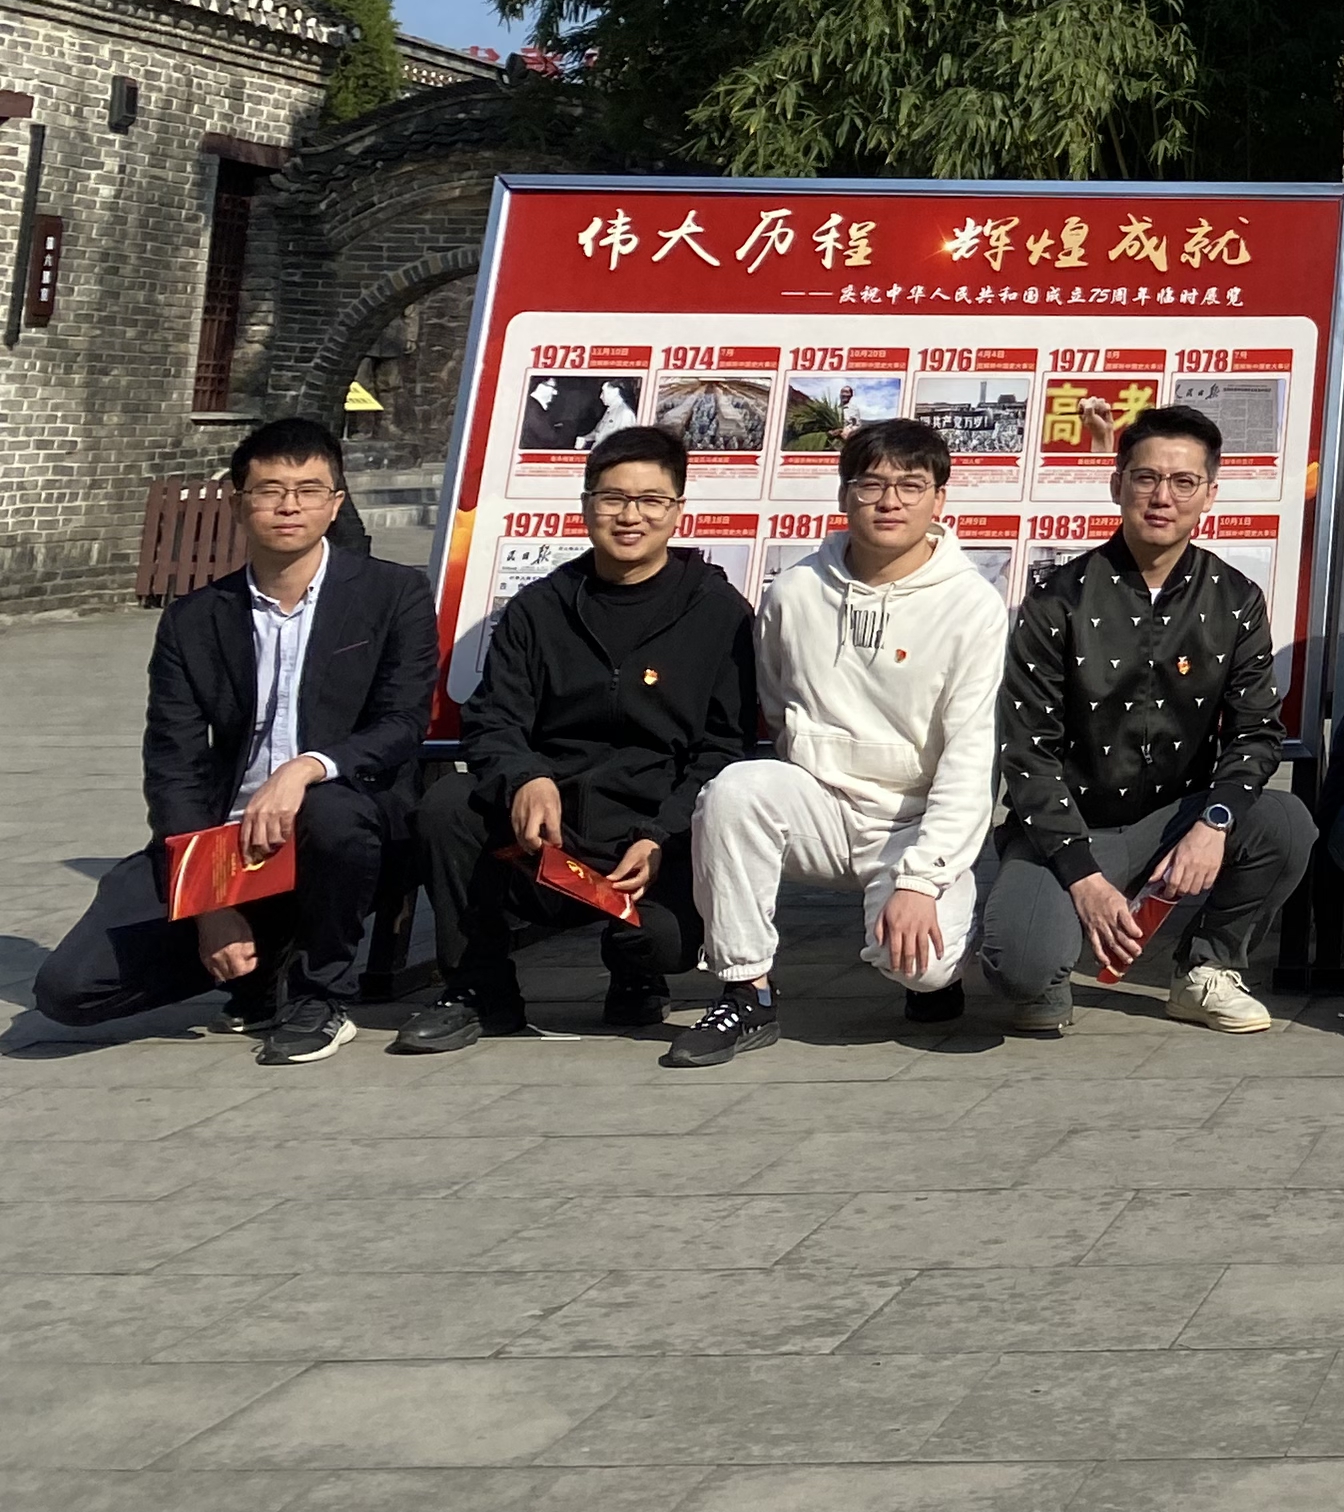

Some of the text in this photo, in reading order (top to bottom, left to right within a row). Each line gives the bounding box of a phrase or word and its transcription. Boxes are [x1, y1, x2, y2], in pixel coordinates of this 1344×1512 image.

[578, 208, 1252, 274] 伟大历程 辉煌成就
[531, 345, 585, 368] 1973
[662, 346, 714, 369] 1974
[789, 347, 844, 370] 1975
[918, 348, 972, 371] 1976
[1049, 349, 1100, 372] 1977
[1175, 349, 1228, 372] 1978
[503, 513, 559, 537] 1979
[768, 514, 823, 538] 1981
[1027, 515, 1085, 539] 1983
[1219, 517, 1252, 525] 10月1日
